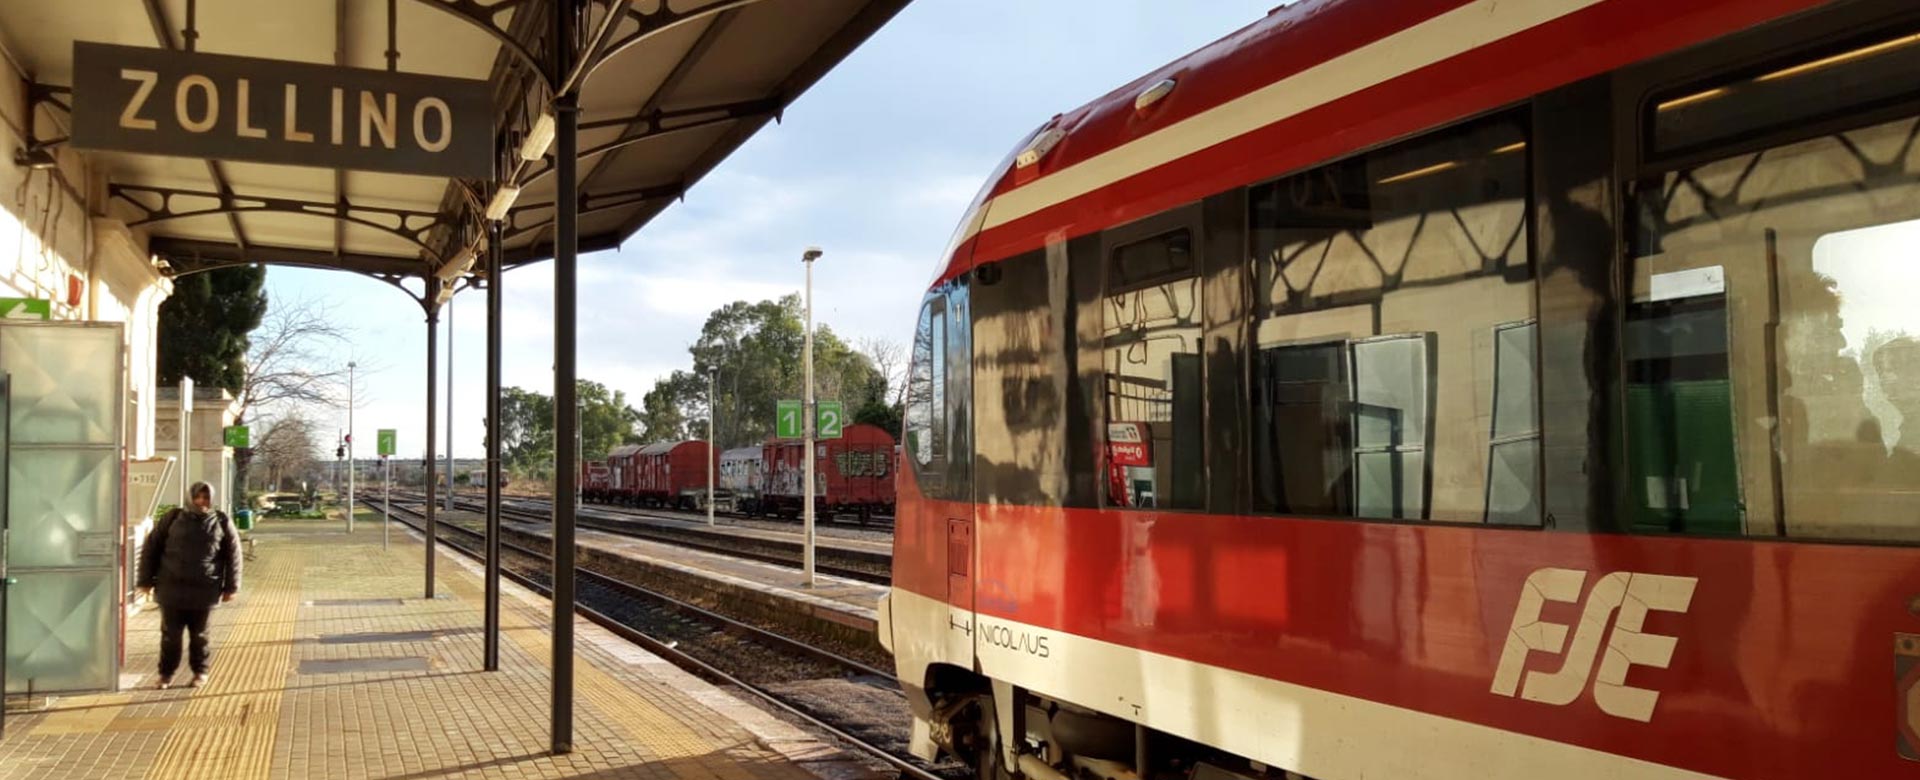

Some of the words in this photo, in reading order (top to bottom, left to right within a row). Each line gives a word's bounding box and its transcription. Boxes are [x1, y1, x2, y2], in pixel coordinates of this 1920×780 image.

[120, 69, 452, 152] ZOLLINO
[783, 411, 796, 435] 1
[821, 411, 839, 435] 2
[382, 436, 391, 453] 1
[980, 622, 1050, 658] NICOLAUS
[1490, 567, 1699, 723] FSE
